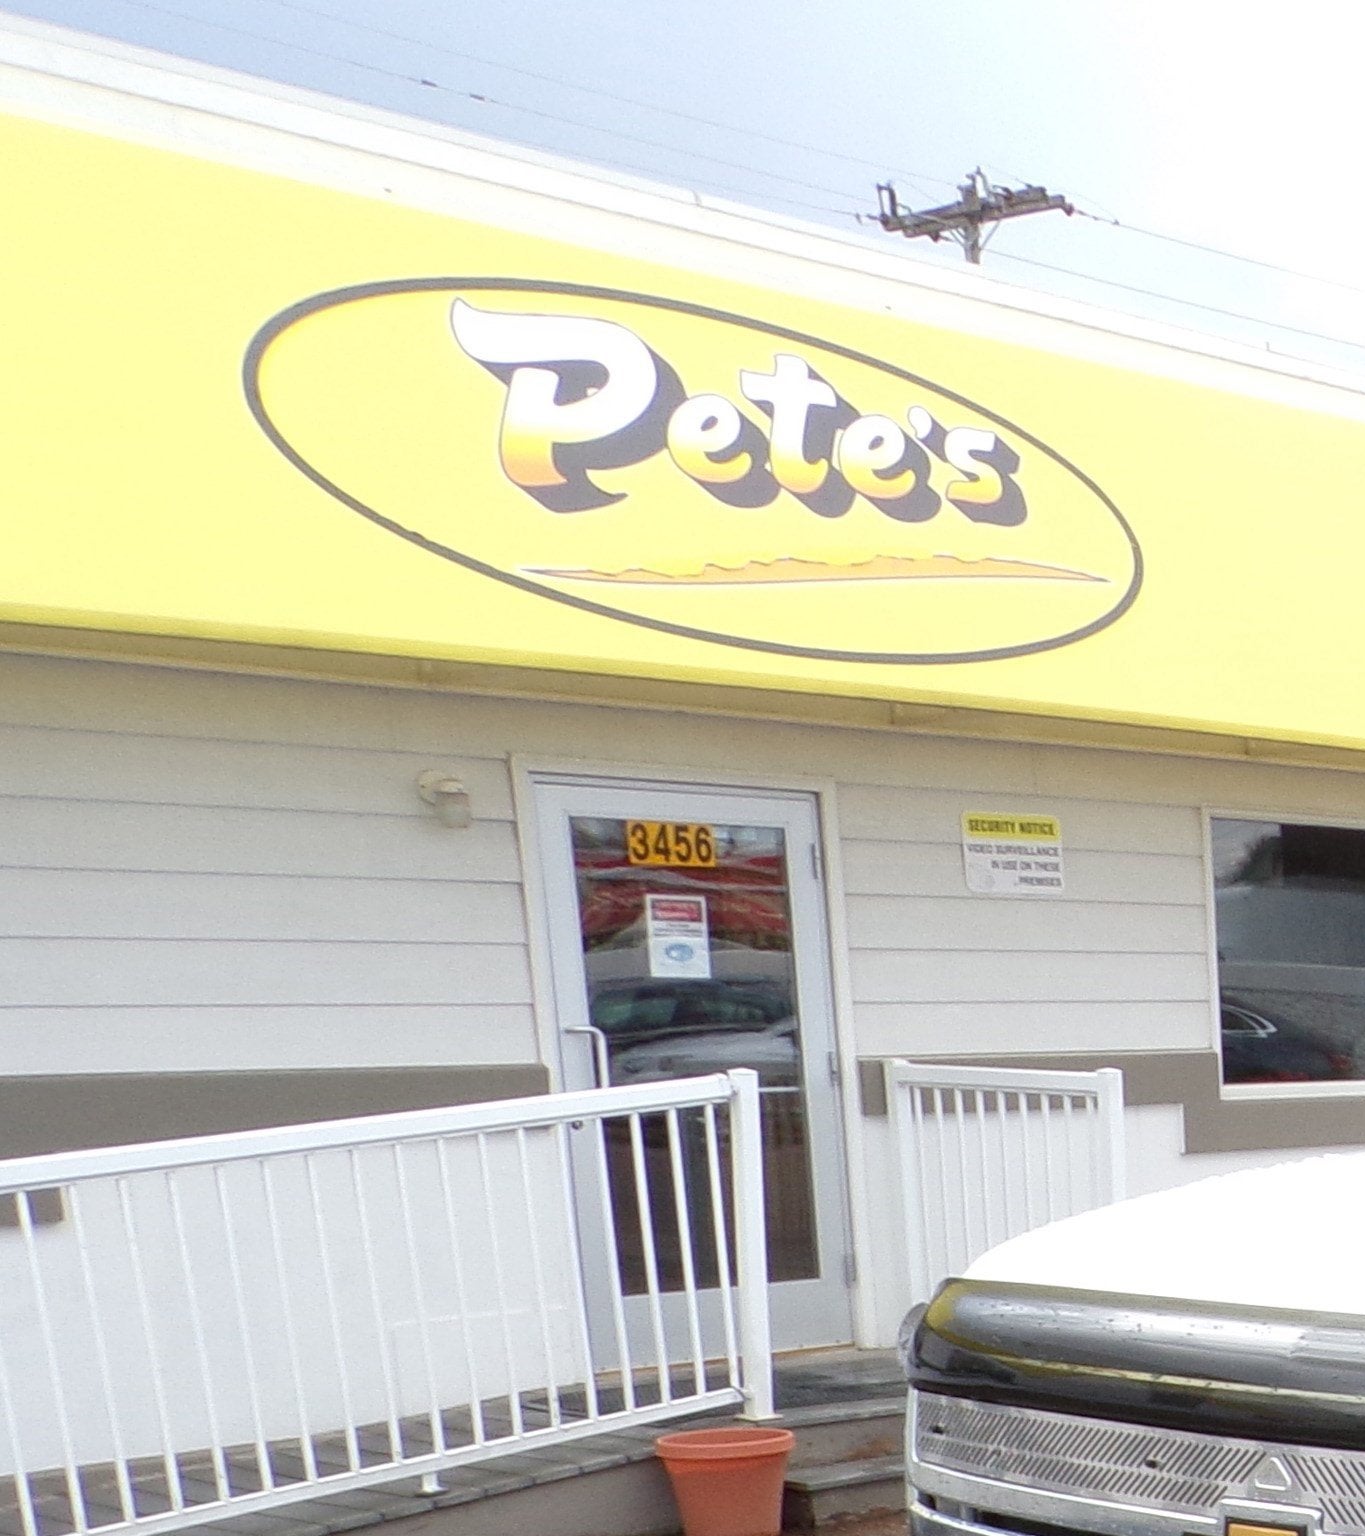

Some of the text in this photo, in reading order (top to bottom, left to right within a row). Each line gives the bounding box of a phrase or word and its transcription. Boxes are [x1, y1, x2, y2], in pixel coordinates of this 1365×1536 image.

[450, 297, 1018, 520] Pete's
[968, 818, 1055, 836] SECURITY NOTICE
[630, 823, 712, 863] 3456
[967, 843, 1059, 857] VIDEO SURVEILLANCE
